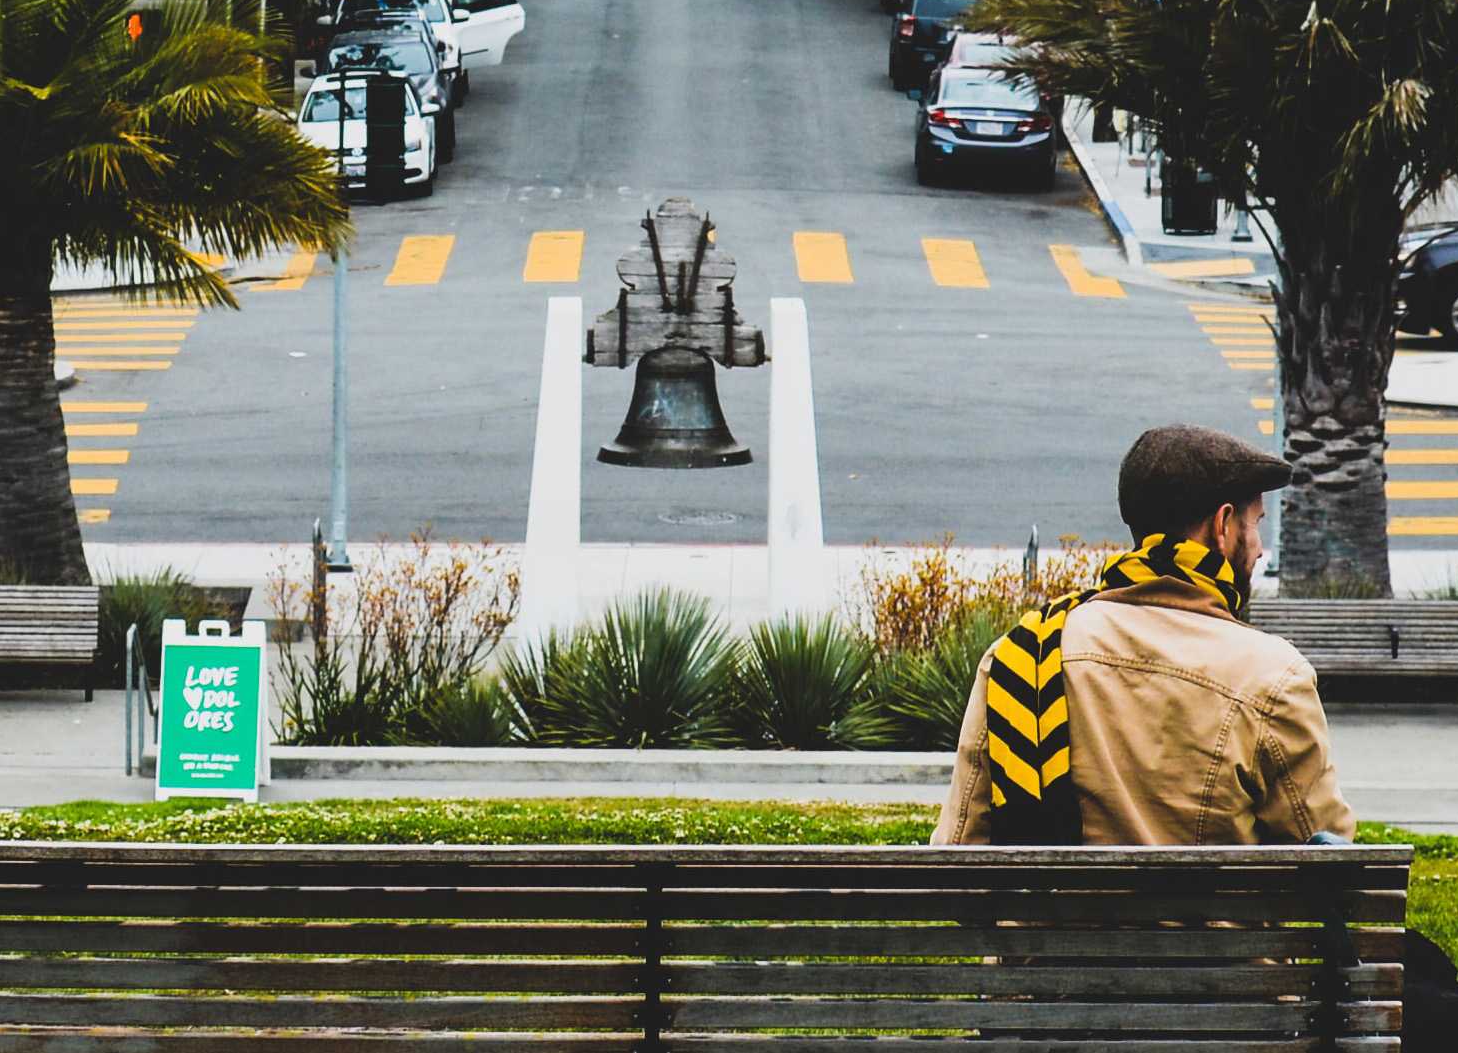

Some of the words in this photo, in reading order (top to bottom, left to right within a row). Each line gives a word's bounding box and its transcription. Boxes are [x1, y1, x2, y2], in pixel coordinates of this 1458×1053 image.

[185, 666, 240, 687] LOVE
[203, 690, 241, 709] DOL
[183, 710, 235, 732] ORES
